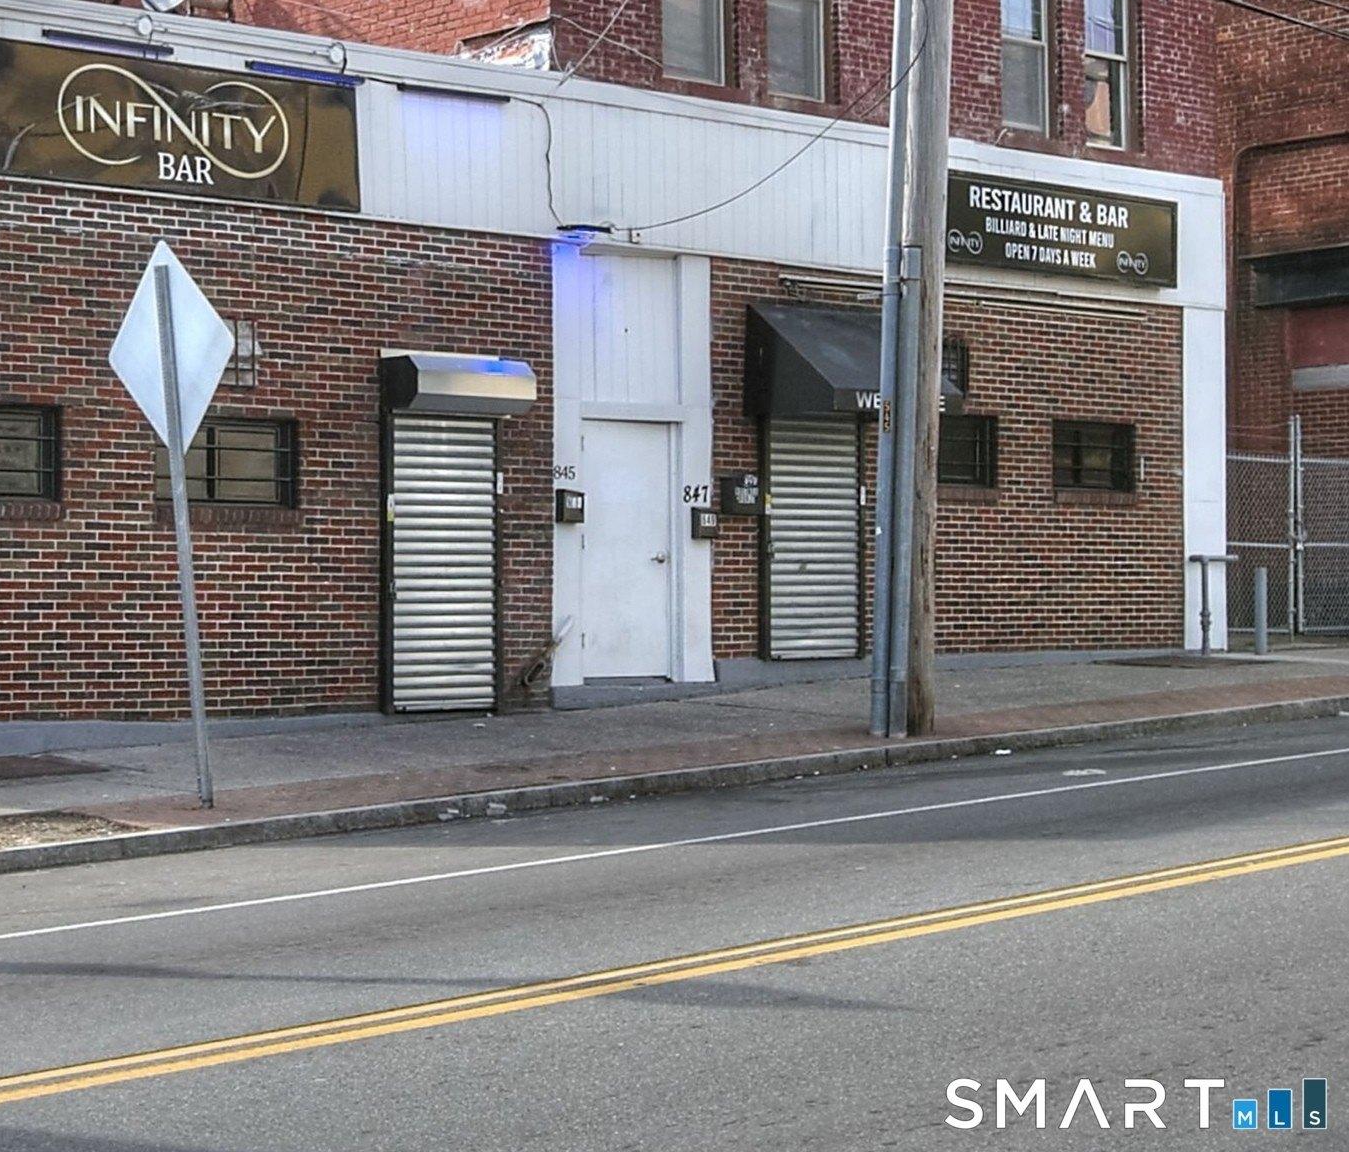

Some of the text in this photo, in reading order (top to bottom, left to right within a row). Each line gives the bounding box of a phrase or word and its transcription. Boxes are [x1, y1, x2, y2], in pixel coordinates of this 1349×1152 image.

[75, 94, 277, 153] INFINITY
[158, 151, 215, 185] BAR
[969, 185, 1128, 229] RESTAURANT & BAR
[985, 216, 1115, 249] BILLIARD & LATE NIGHT MENU
[1005, 242, 1097, 269] OPEN 7 DAYS A WEEK
[554, 465, 576, 480] 845
[683, 485, 709, 503] 847
